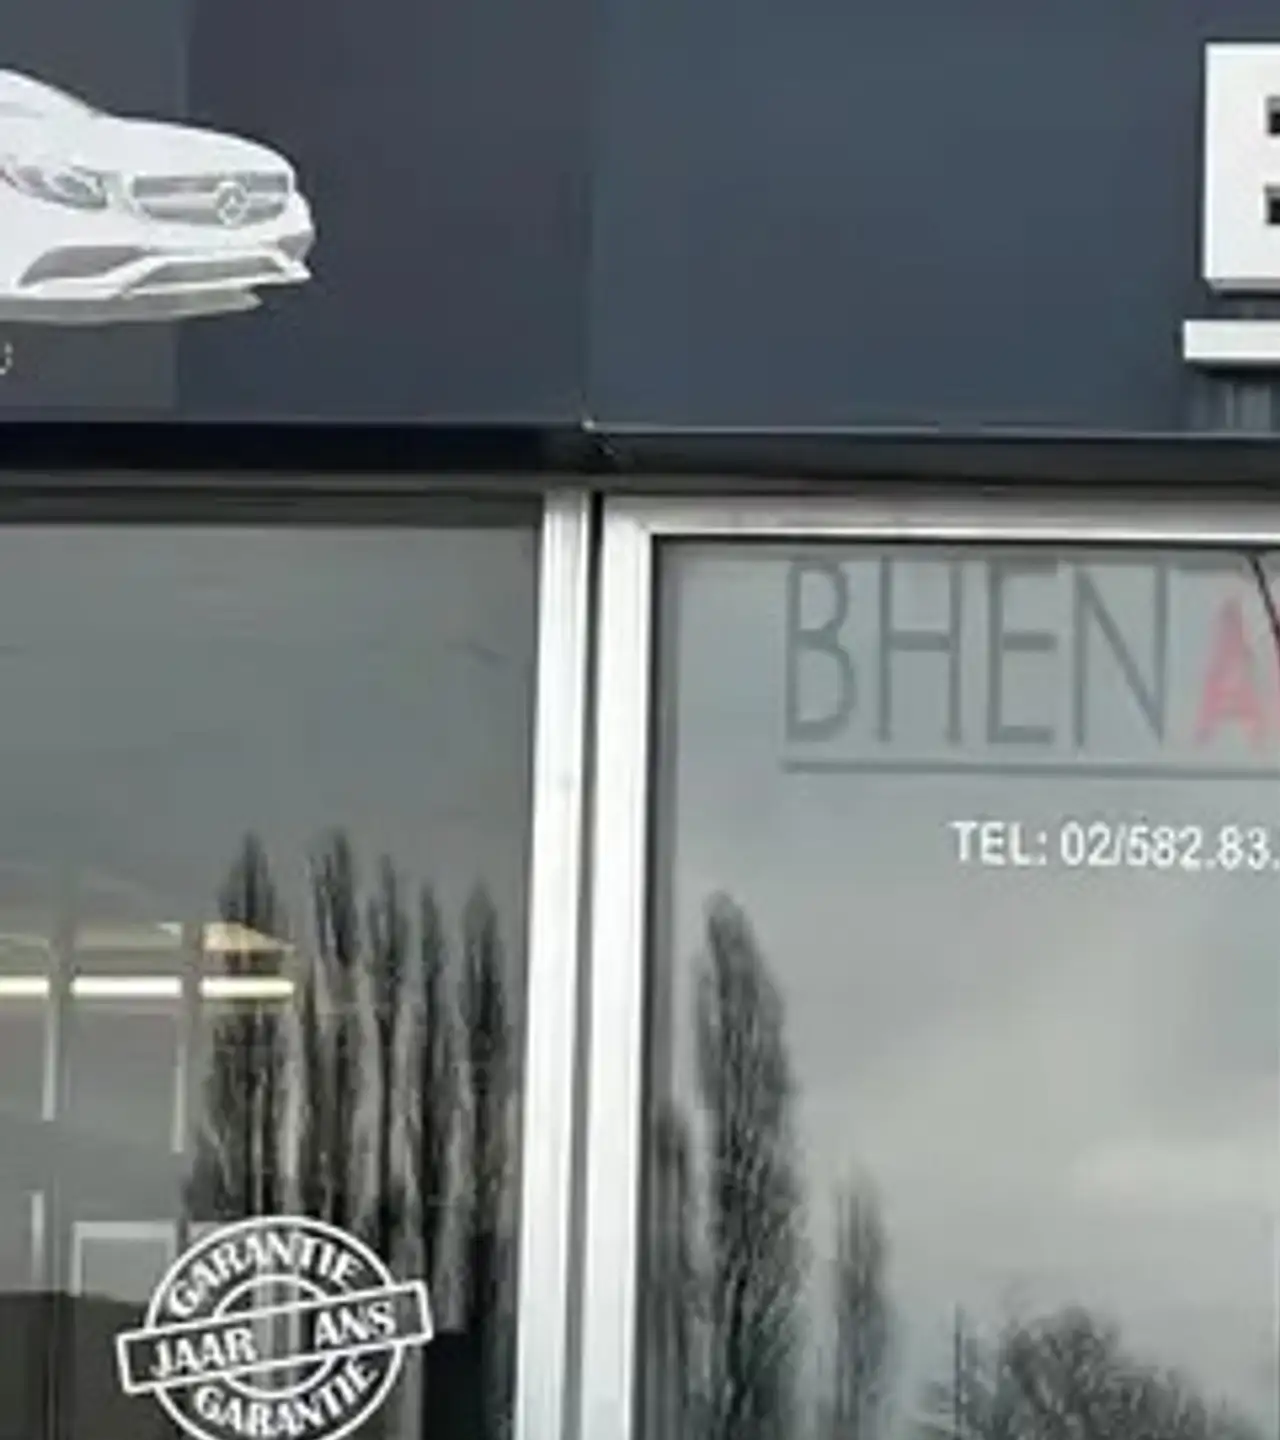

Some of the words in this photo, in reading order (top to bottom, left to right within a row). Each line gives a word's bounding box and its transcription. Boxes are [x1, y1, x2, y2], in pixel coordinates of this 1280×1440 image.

[784, 554, 1169, 746] BHEN
[949, 820, 1048, 866] TEL:
[168, 1231, 364, 1318] GARANTIE
[150, 1326, 257, 1378] JAAR
[313, 1300, 397, 1348] ANS
[193, 1360, 379, 1437] GARANTIE
